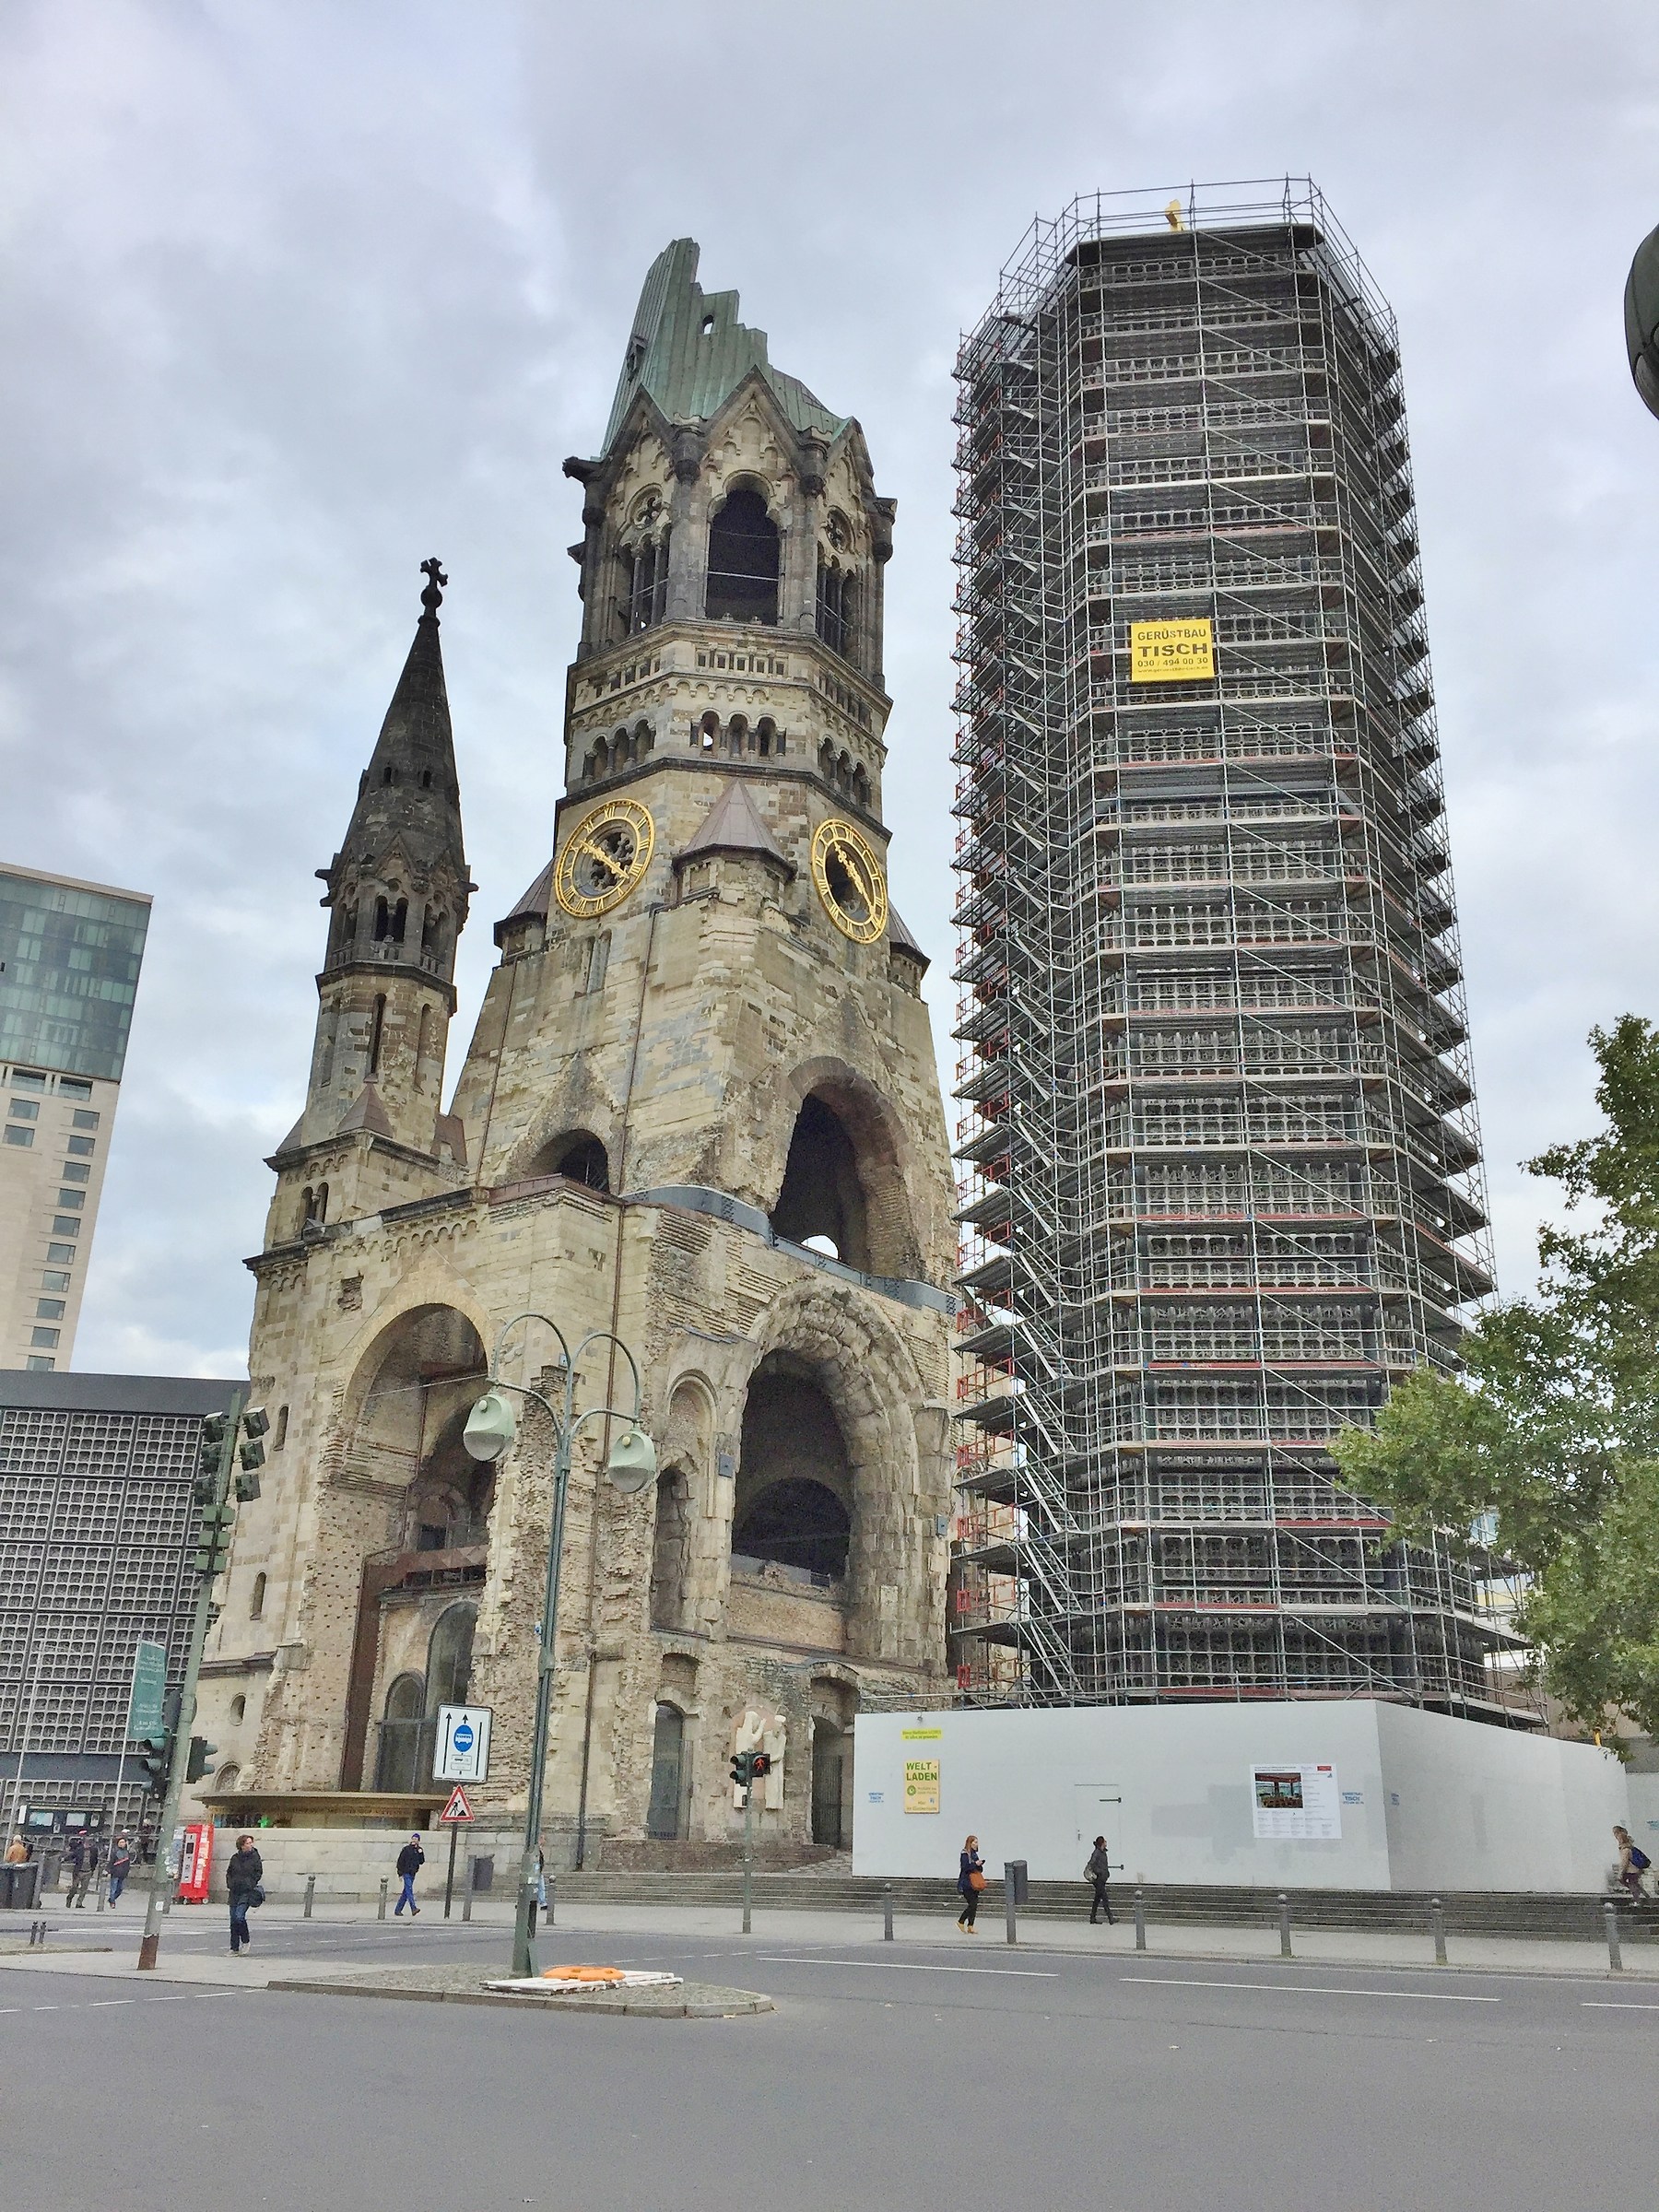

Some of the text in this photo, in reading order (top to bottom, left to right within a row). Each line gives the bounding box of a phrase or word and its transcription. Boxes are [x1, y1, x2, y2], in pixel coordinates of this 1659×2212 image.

[1137, 628, 1207, 641] GERÜSTBAU
[1137, 642, 1208, 658] TISCH
[1163, 658, 1180, 666] 494
[1197, 656, 1208, 665] 30
[906, 1761, 932, 1771] WELT
[906, 1771, 937, 1782] LADEN
